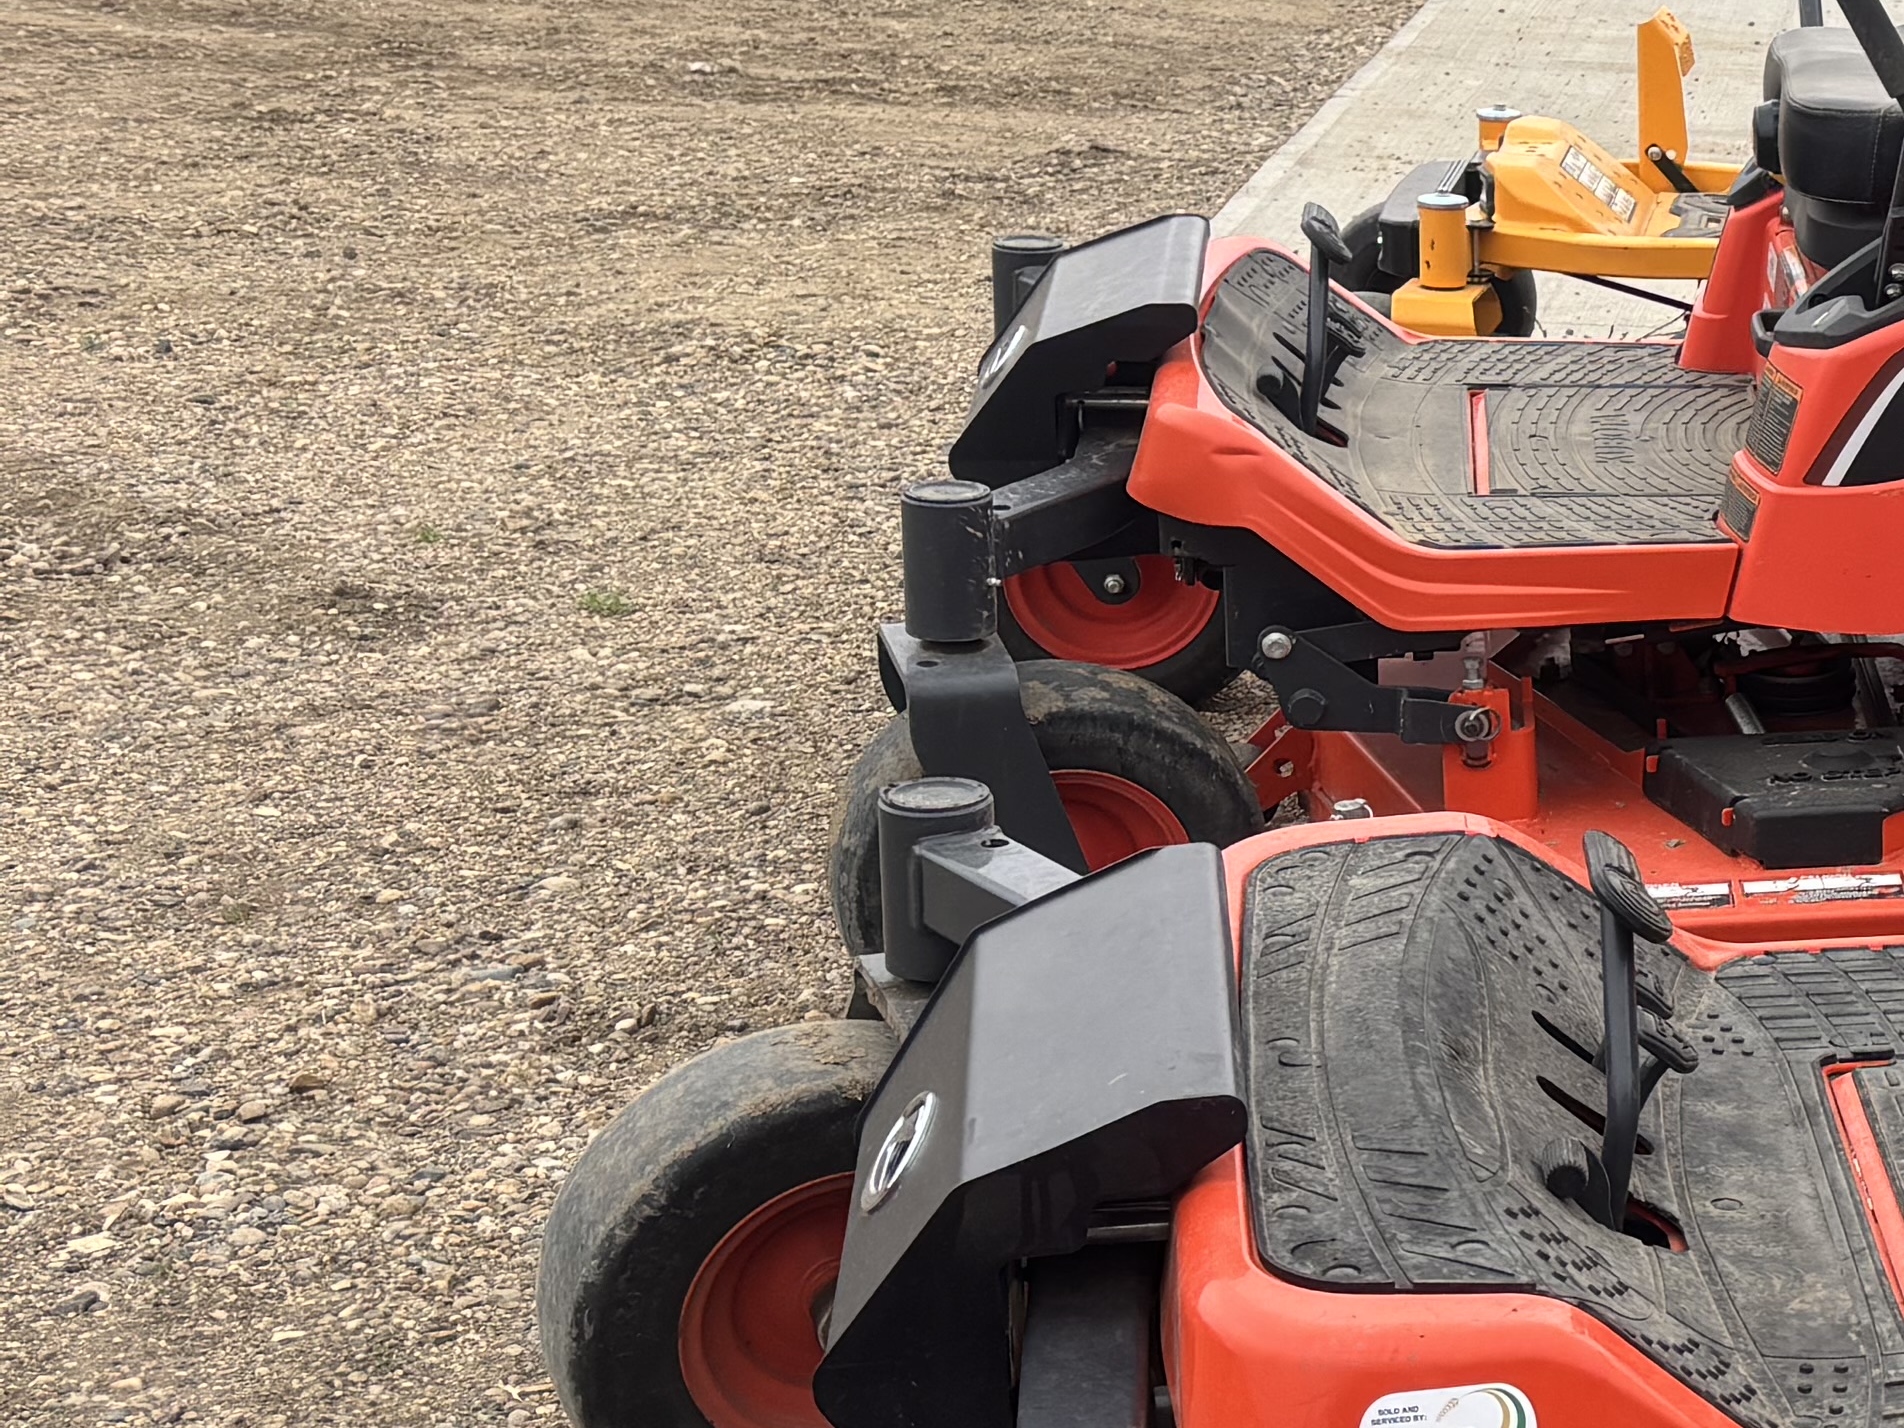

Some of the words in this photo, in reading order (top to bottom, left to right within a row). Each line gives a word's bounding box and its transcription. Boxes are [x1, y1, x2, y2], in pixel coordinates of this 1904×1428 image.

[1378, 1408, 1400, 1416] SOLD
[1402, 1406, 1419, 1414] AND
[1371, 1416, 1411, 1426] SERVICED
[1413, 1414, 1427, 1422] BY:
